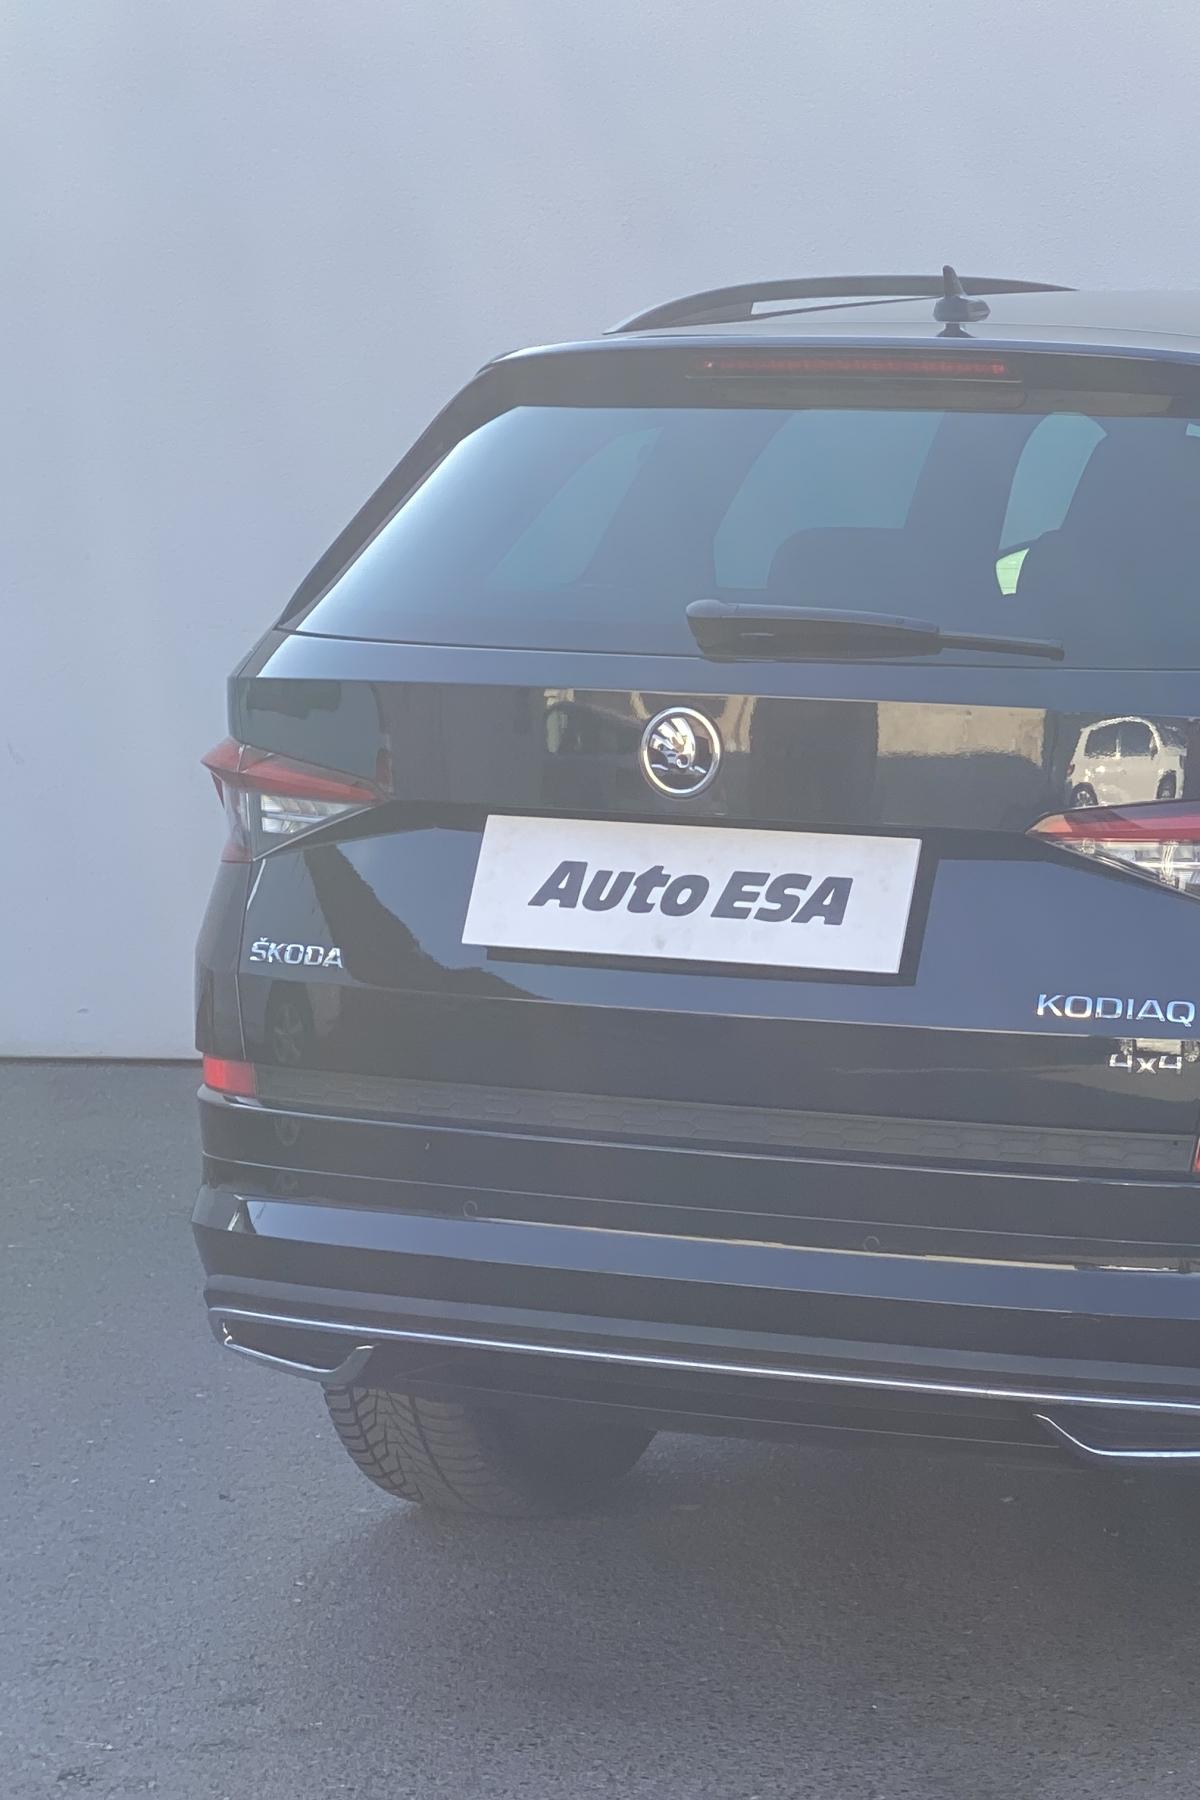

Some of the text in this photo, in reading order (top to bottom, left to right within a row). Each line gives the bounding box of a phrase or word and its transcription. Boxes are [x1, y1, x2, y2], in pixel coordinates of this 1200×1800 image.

[528, 860, 854, 926] Auto ESA
[249, 937, 343, 969] ŠKODA
[1036, 994, 1196, 1027] KODIAQ
[1109, 1053, 1183, 1074] 4x4
